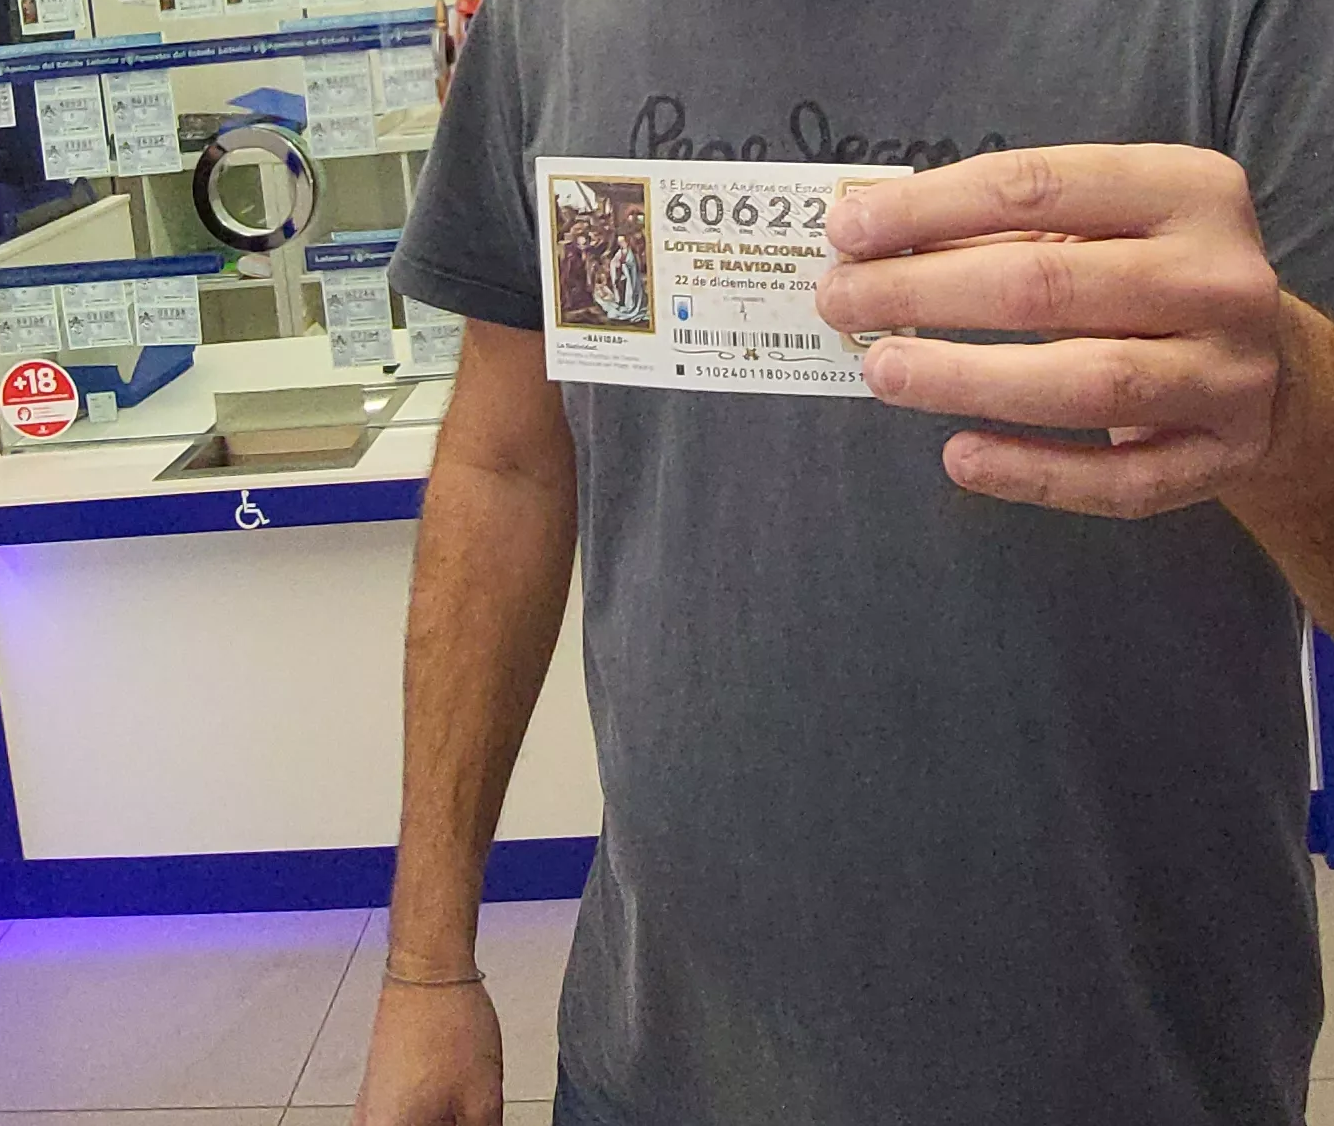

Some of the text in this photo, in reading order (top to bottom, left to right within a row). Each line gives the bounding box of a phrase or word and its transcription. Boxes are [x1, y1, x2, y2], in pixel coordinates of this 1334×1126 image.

[665, 193, 827, 229] 60622
[739, 243, 827, 258] NACIONAL
[693, 258, 797, 274] DE NAVIDAD
[674, 275, 817, 292] 22 de diciembre de 2024
[13, 367, 58, 395] +18
